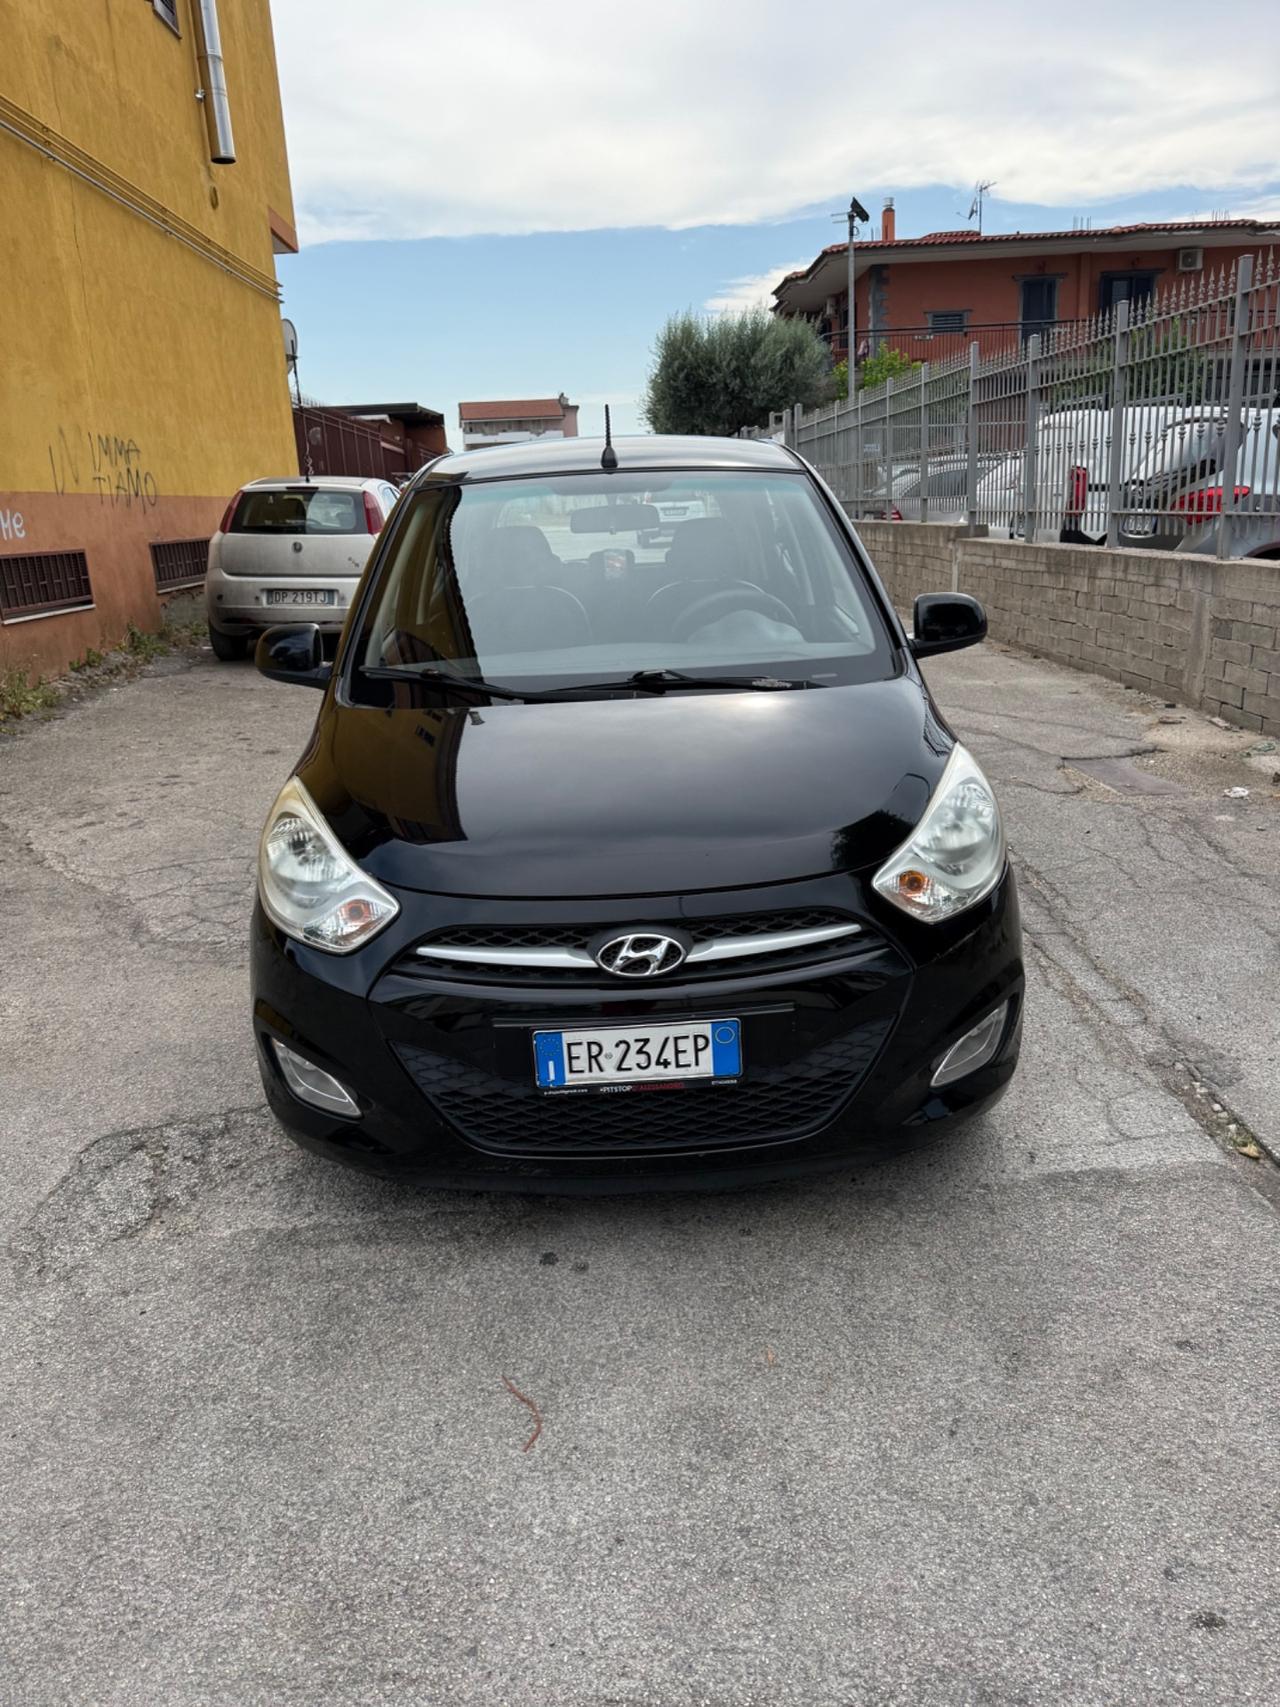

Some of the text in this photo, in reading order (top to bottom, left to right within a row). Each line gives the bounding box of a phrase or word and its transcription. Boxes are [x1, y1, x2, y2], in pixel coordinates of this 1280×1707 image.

[274, 591, 326, 603] DP 219TJ
[566, 1034, 710, 1074] ER 234EP
